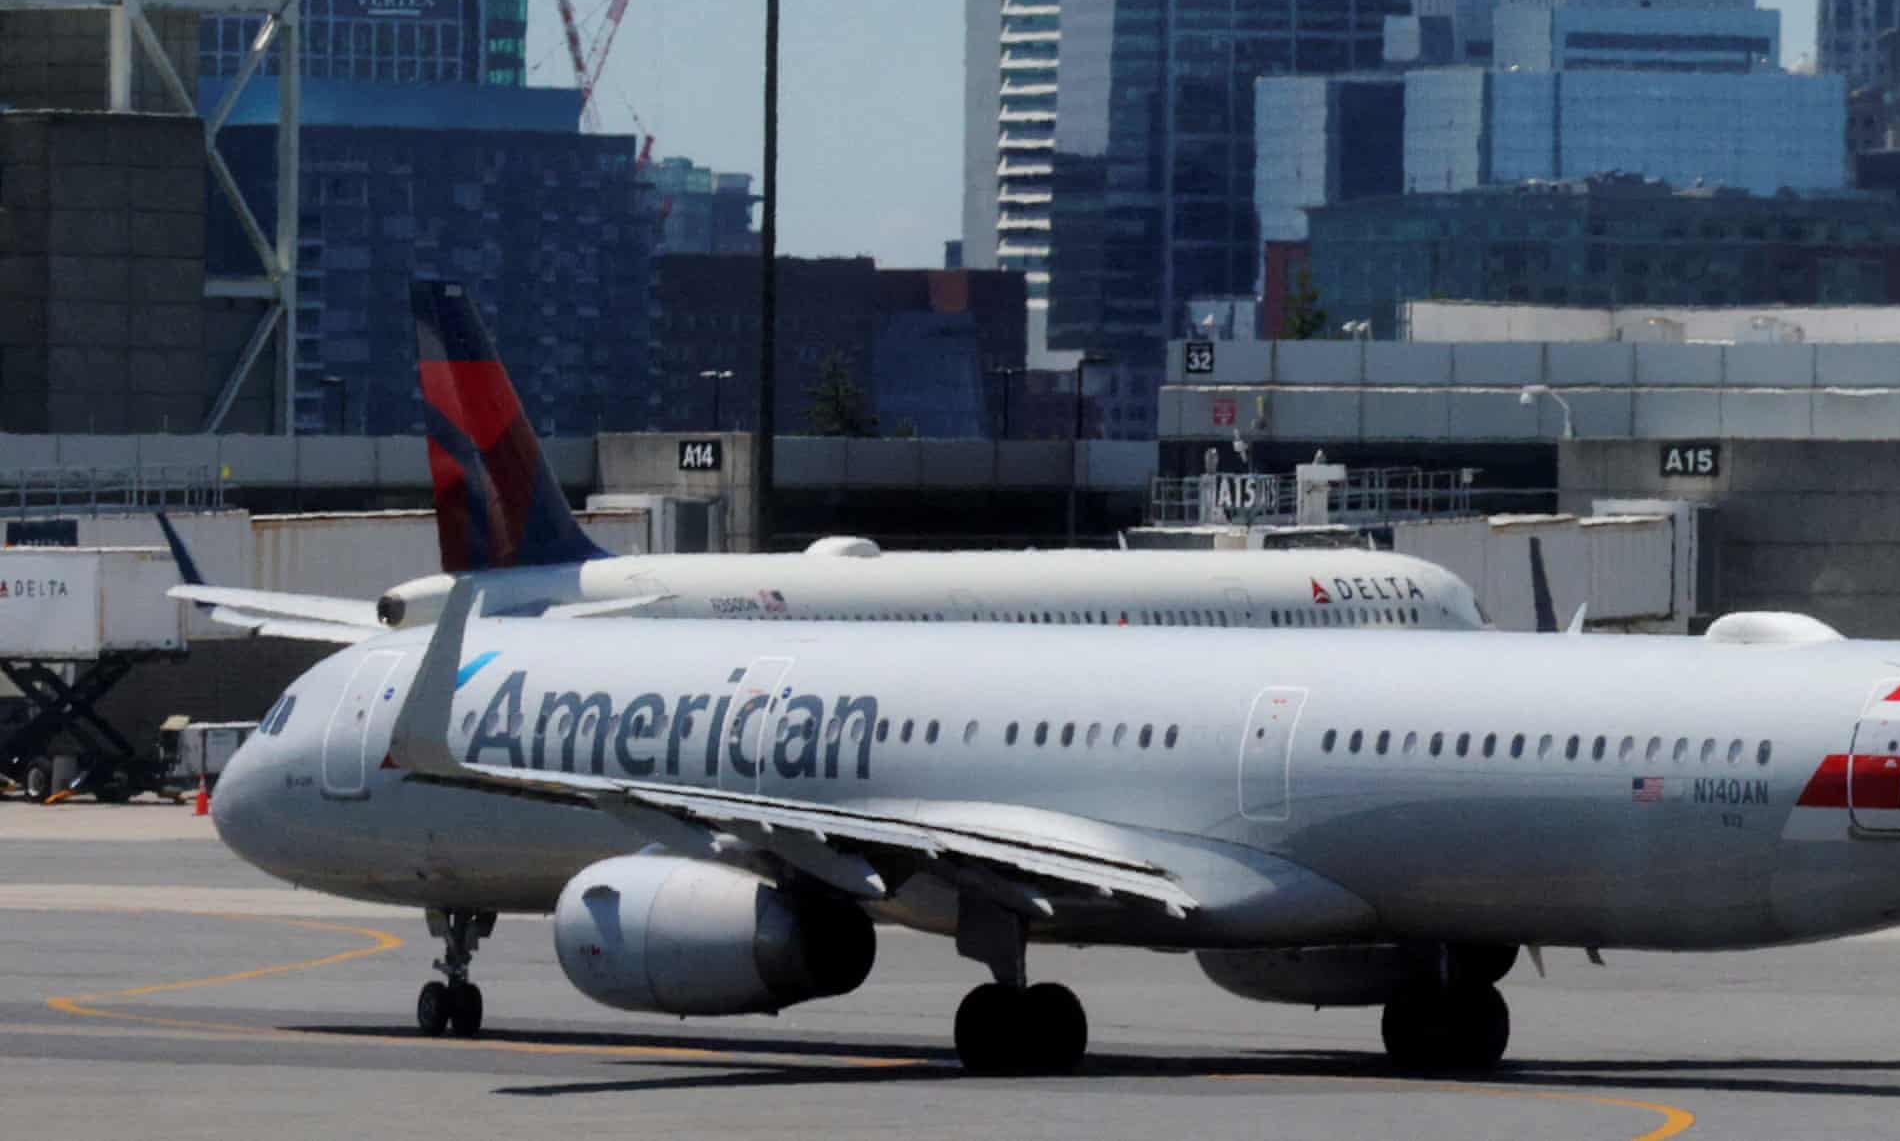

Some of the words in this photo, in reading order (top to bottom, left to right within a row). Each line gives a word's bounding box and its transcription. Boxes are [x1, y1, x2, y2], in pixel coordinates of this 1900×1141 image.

[1188, 353, 1211, 370] 32
[683, 443, 714, 467] A14
[1664, 449, 1712, 473] A15
[1217, 477, 1256, 508] A15
[15, 579, 68, 597] DELTA
[1333, 578, 1424, 600] DELTA
[465, 667, 880, 780] American
[1694, 778, 1769, 804] N140AN
